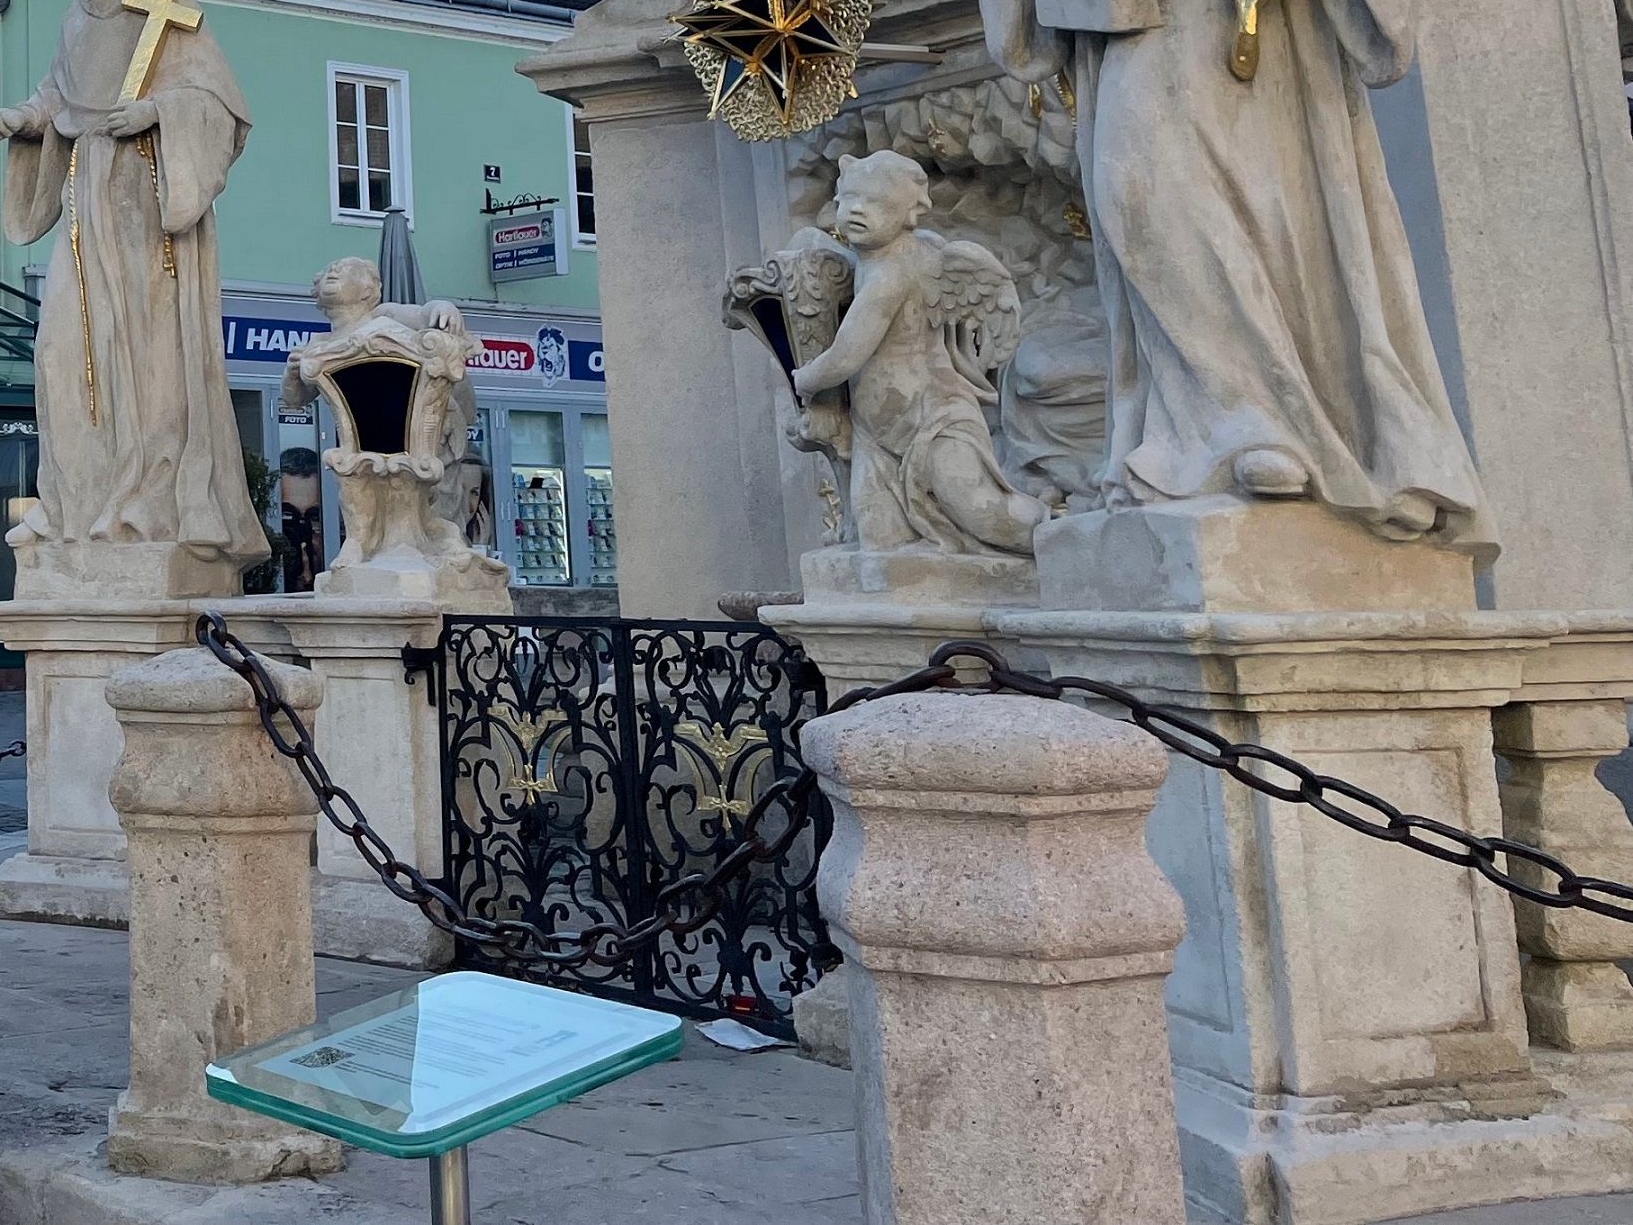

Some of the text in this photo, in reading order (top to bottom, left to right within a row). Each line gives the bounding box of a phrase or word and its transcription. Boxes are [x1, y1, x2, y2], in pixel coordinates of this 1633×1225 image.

[490, 167, 496, 176] 7
[498, 229, 537, 243] Hartlauer
[246, 328, 314, 352] HAN
